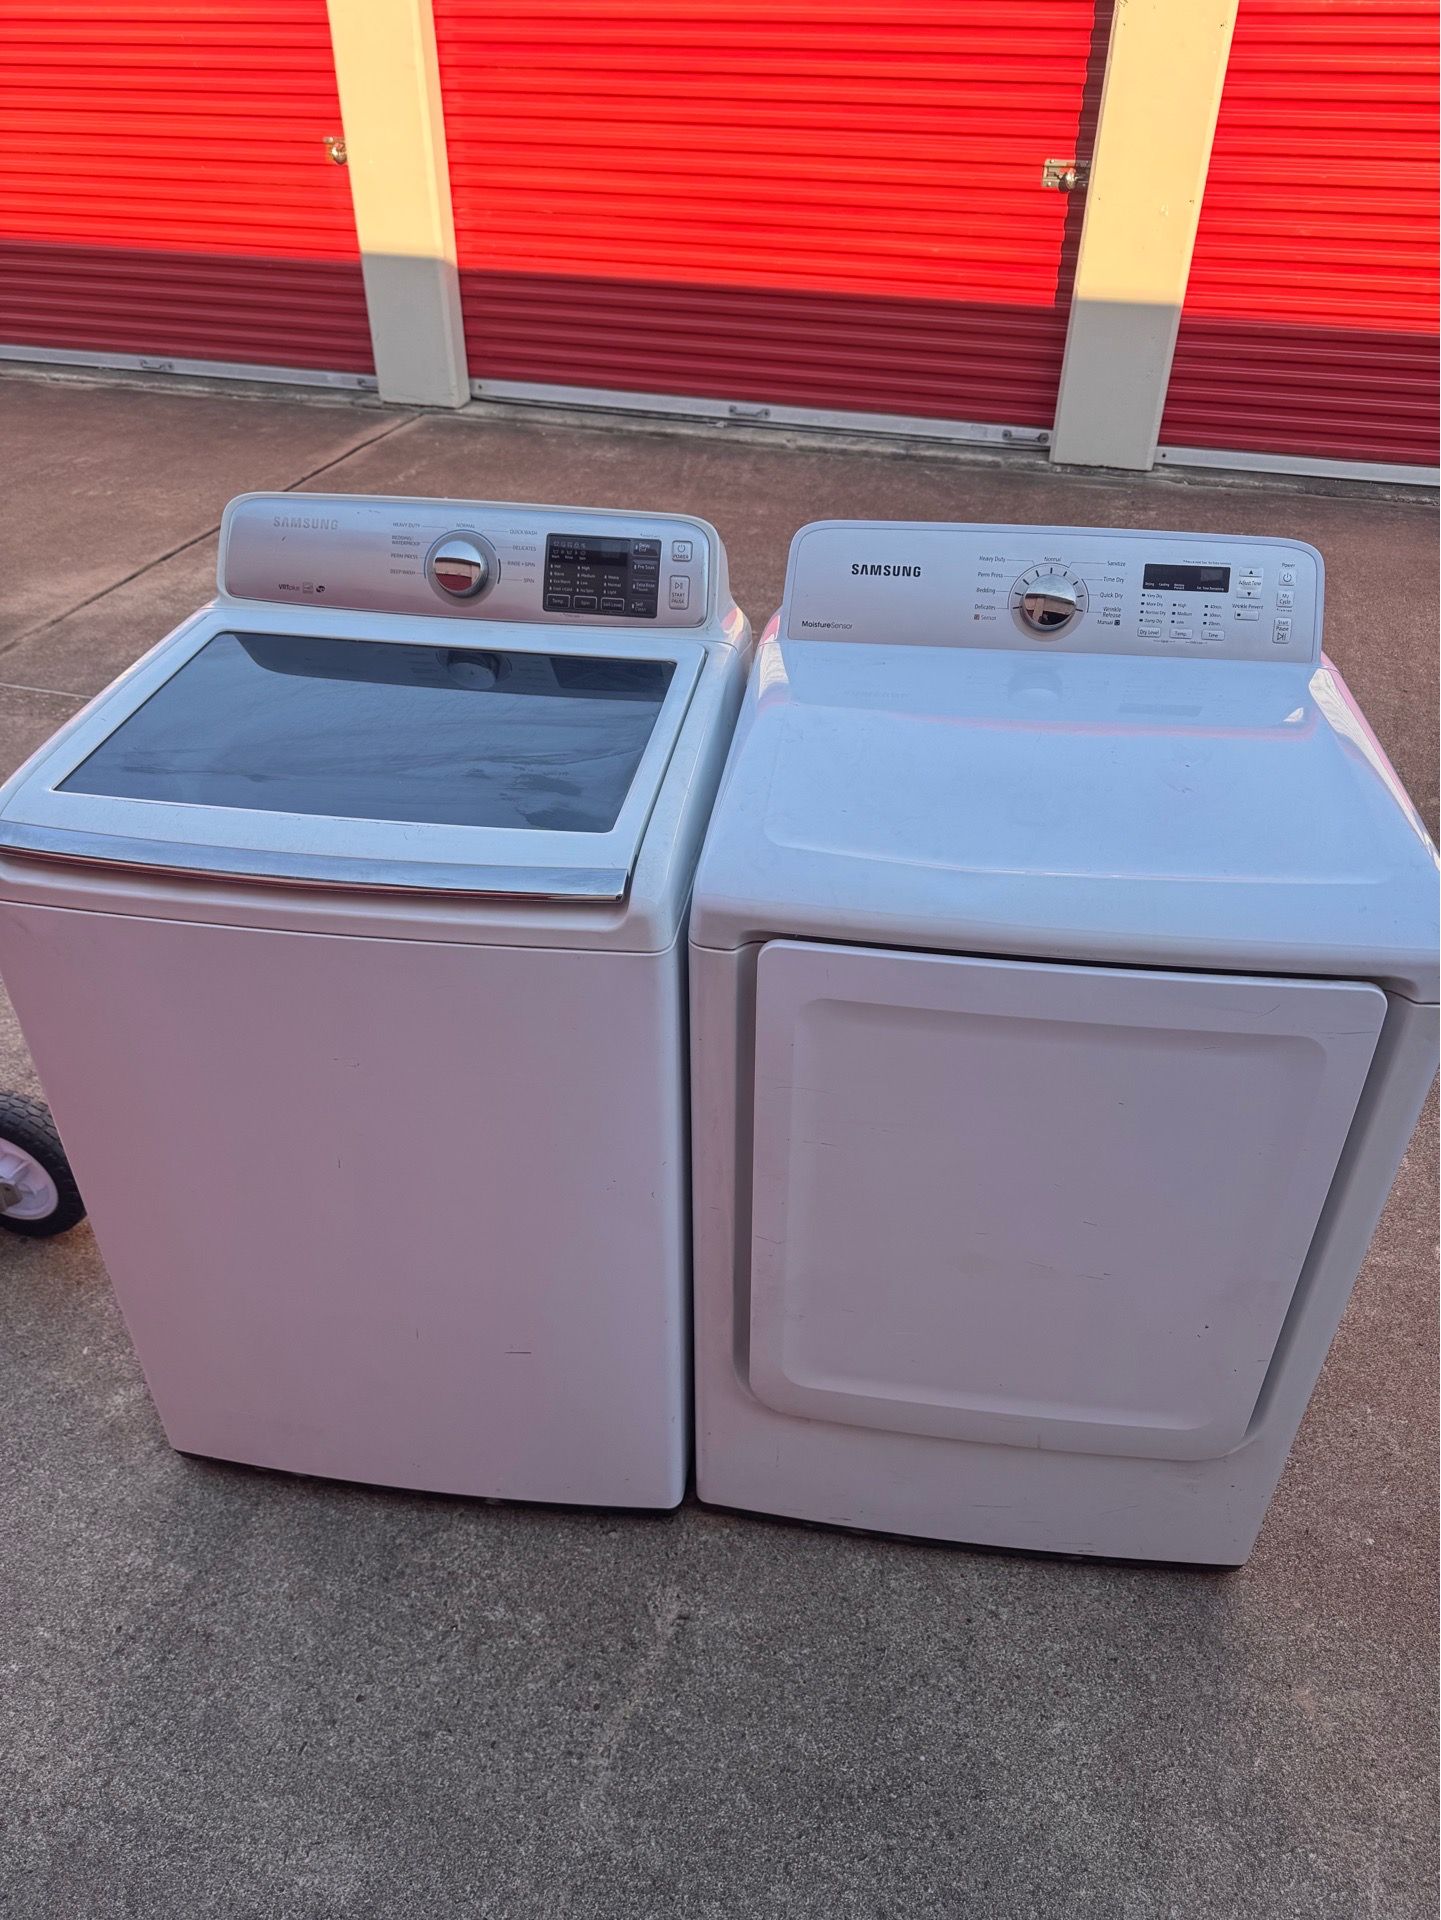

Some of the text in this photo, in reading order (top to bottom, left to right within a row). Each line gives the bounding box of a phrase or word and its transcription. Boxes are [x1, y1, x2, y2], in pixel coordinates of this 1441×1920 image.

[273, 516, 338, 530] SAMSUNG
[512, 544, 536, 552] DELICATES
[851, 563, 921, 577] SAMSUNG
[801, 620, 853, 630] MoistureSensor
